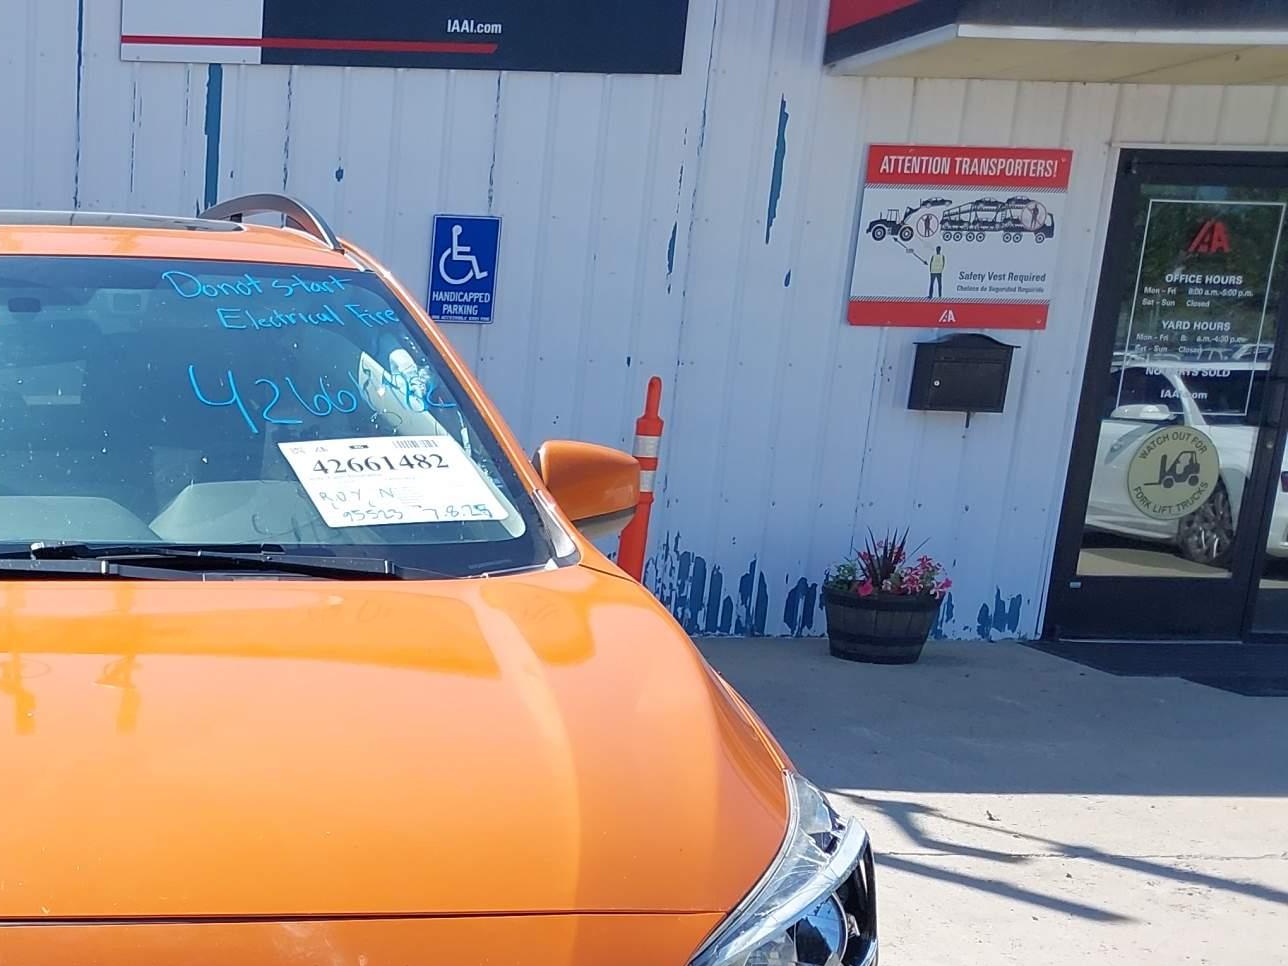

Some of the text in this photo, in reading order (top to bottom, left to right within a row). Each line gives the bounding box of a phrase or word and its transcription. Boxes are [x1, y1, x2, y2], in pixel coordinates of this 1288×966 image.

[447, 19, 502, 34] IAAI.com
[880, 155, 1059, 178] ATTENTION TRANSPORTERS!
[958, 271, 1046, 284] Safety Vest Required
[1165, 273, 1243, 285] OFFICE HOURS
[1144, 286, 1160, 295] Mon
[1167, 287, 1177, 295] Fri
[432, 291, 491, 303] HANDICAPPED
[1142, 298, 1154, 306] Sat
[442, 304, 478, 315] PARKING
[1162, 320, 1231, 331] YARD HOURS
[1136, 333, 1153, 341] Mon
[1159, 334, 1169, 342] Fri
[1146, 367, 1161, 376] NO
[1201, 367, 1231, 378] SOLD
[1139, 431, 1208, 460] WATCH OUT FOR
[312, 453, 449, 475] 42661482
[1133, 481, 1209, 514] FORK LIFT TRUCKS
